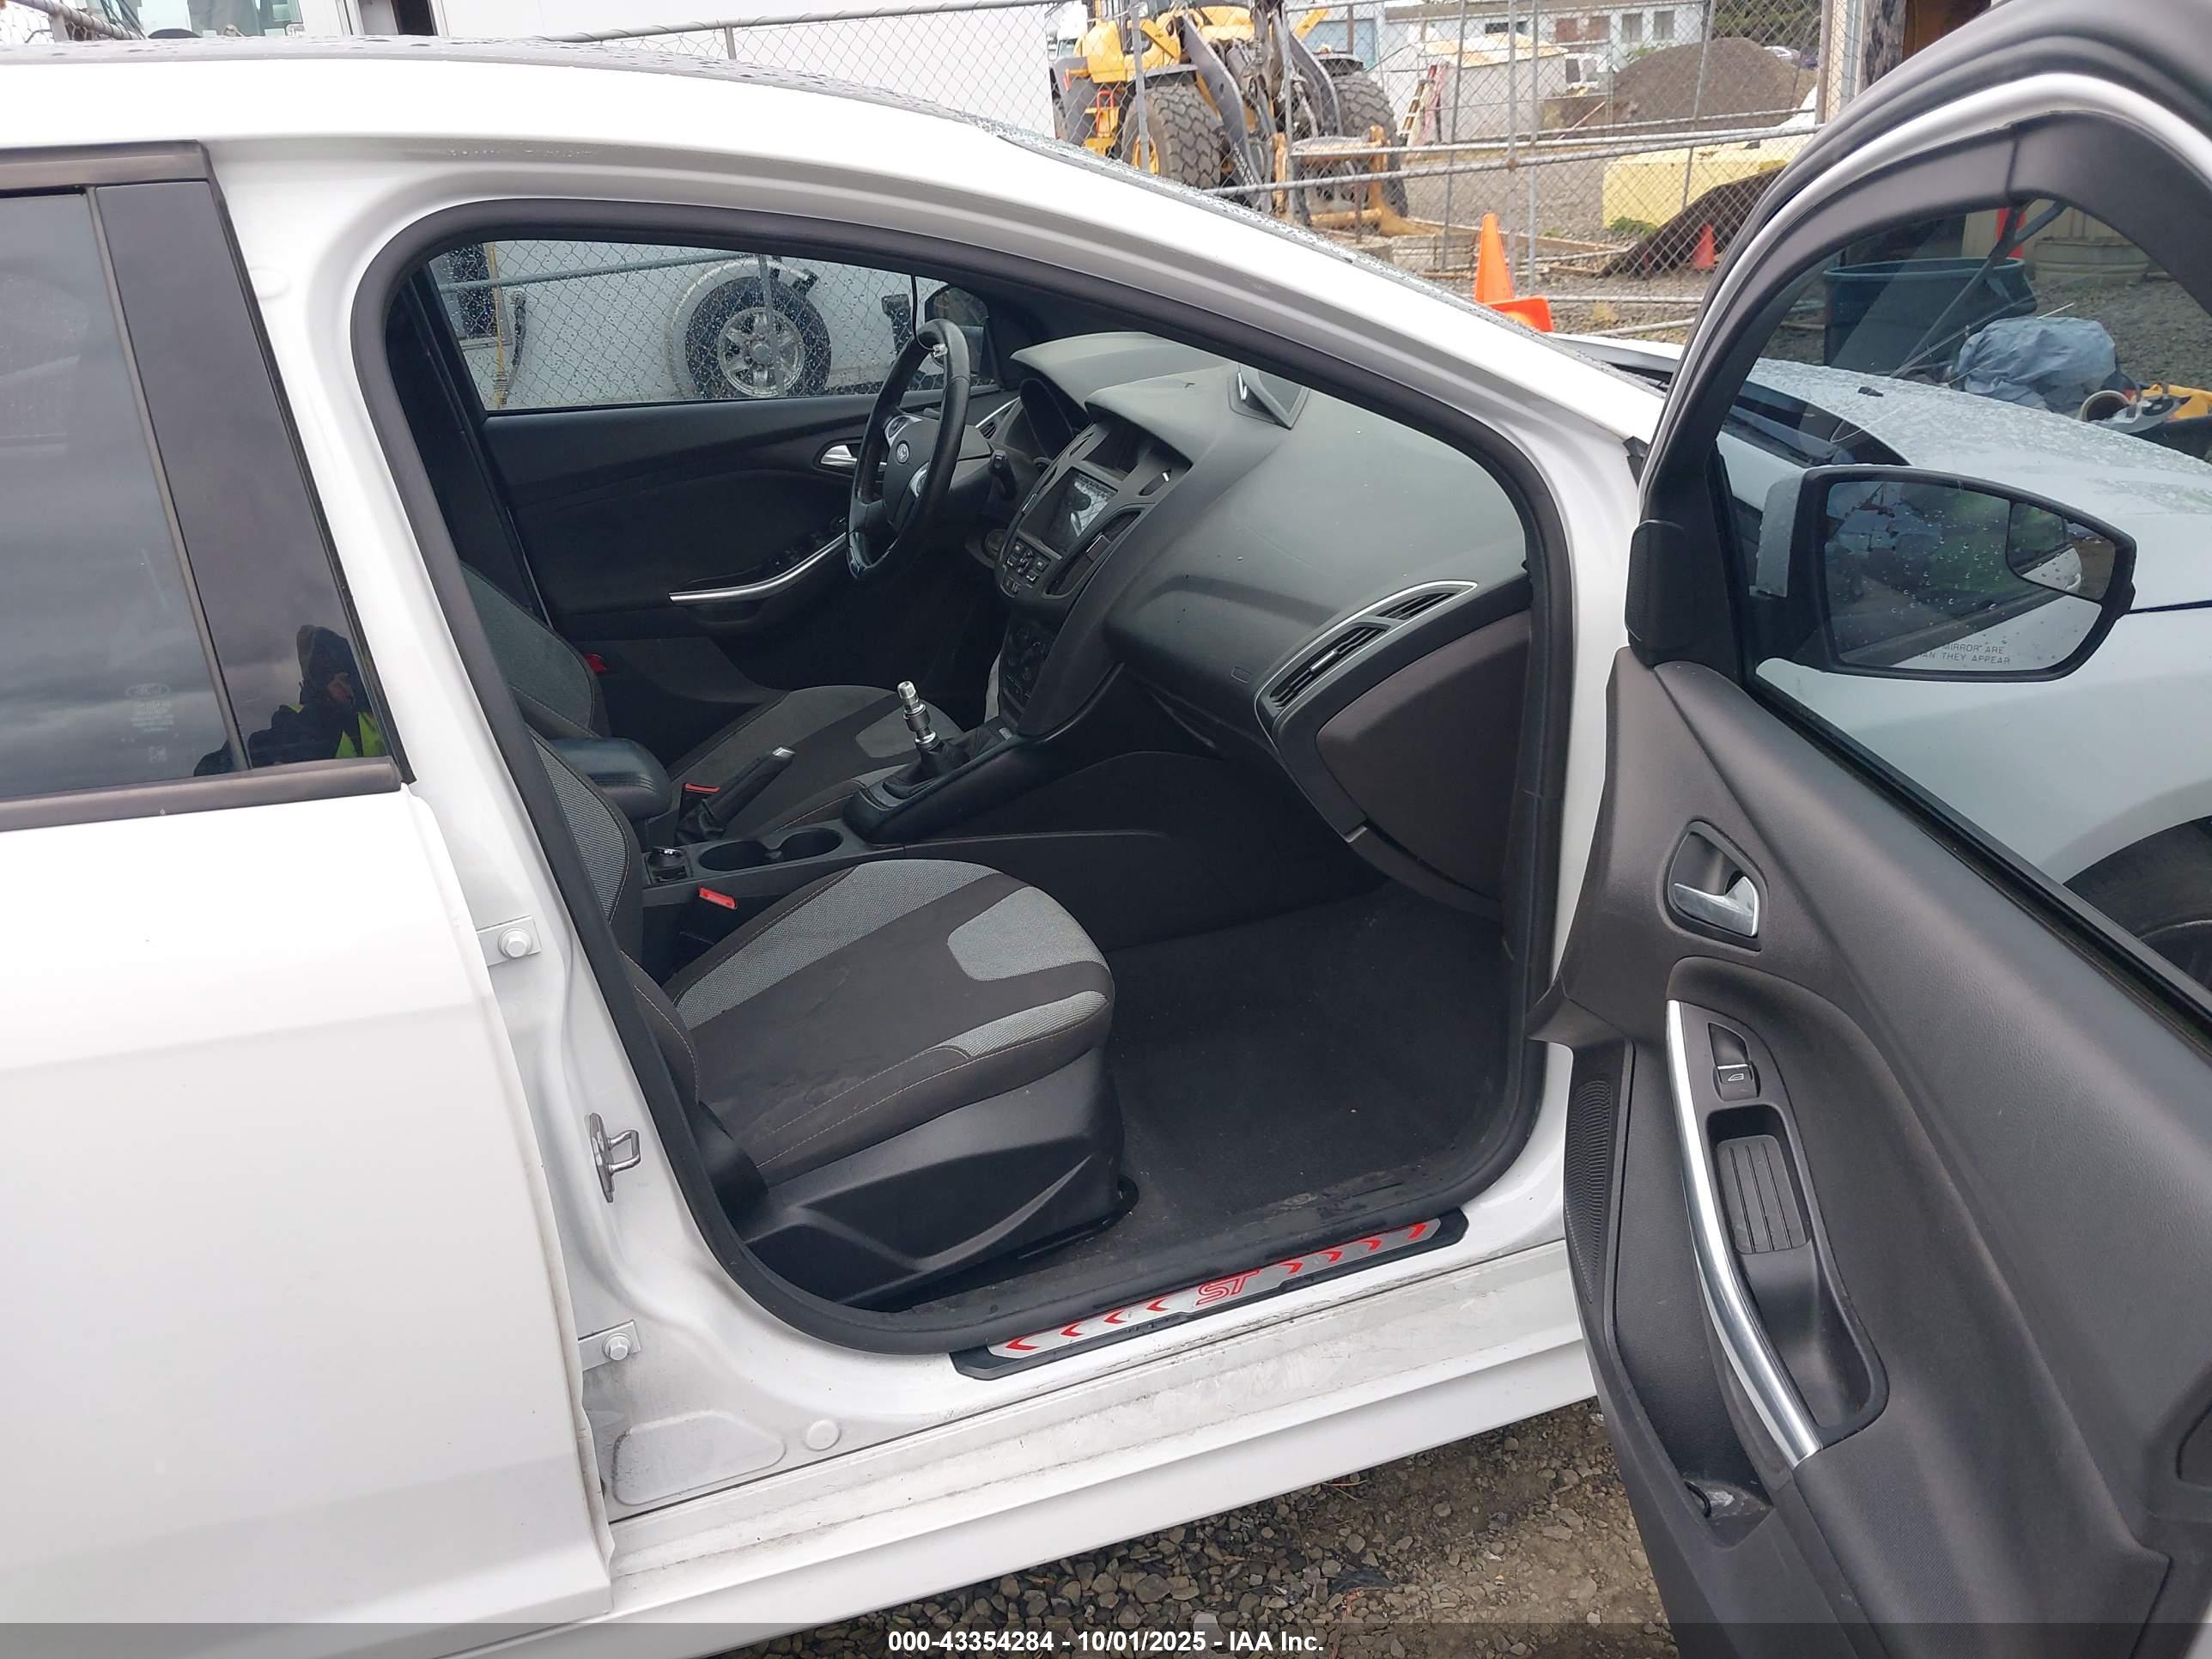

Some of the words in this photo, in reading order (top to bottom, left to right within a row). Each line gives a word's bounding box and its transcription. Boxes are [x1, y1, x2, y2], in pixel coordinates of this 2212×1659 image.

[1984, 646, 2005, 654] ARE
[1942, 652, 1966, 661] THEY
[1972, 654, 2010, 665] APPEAR
[1194, 1267, 1261, 1306] ST
